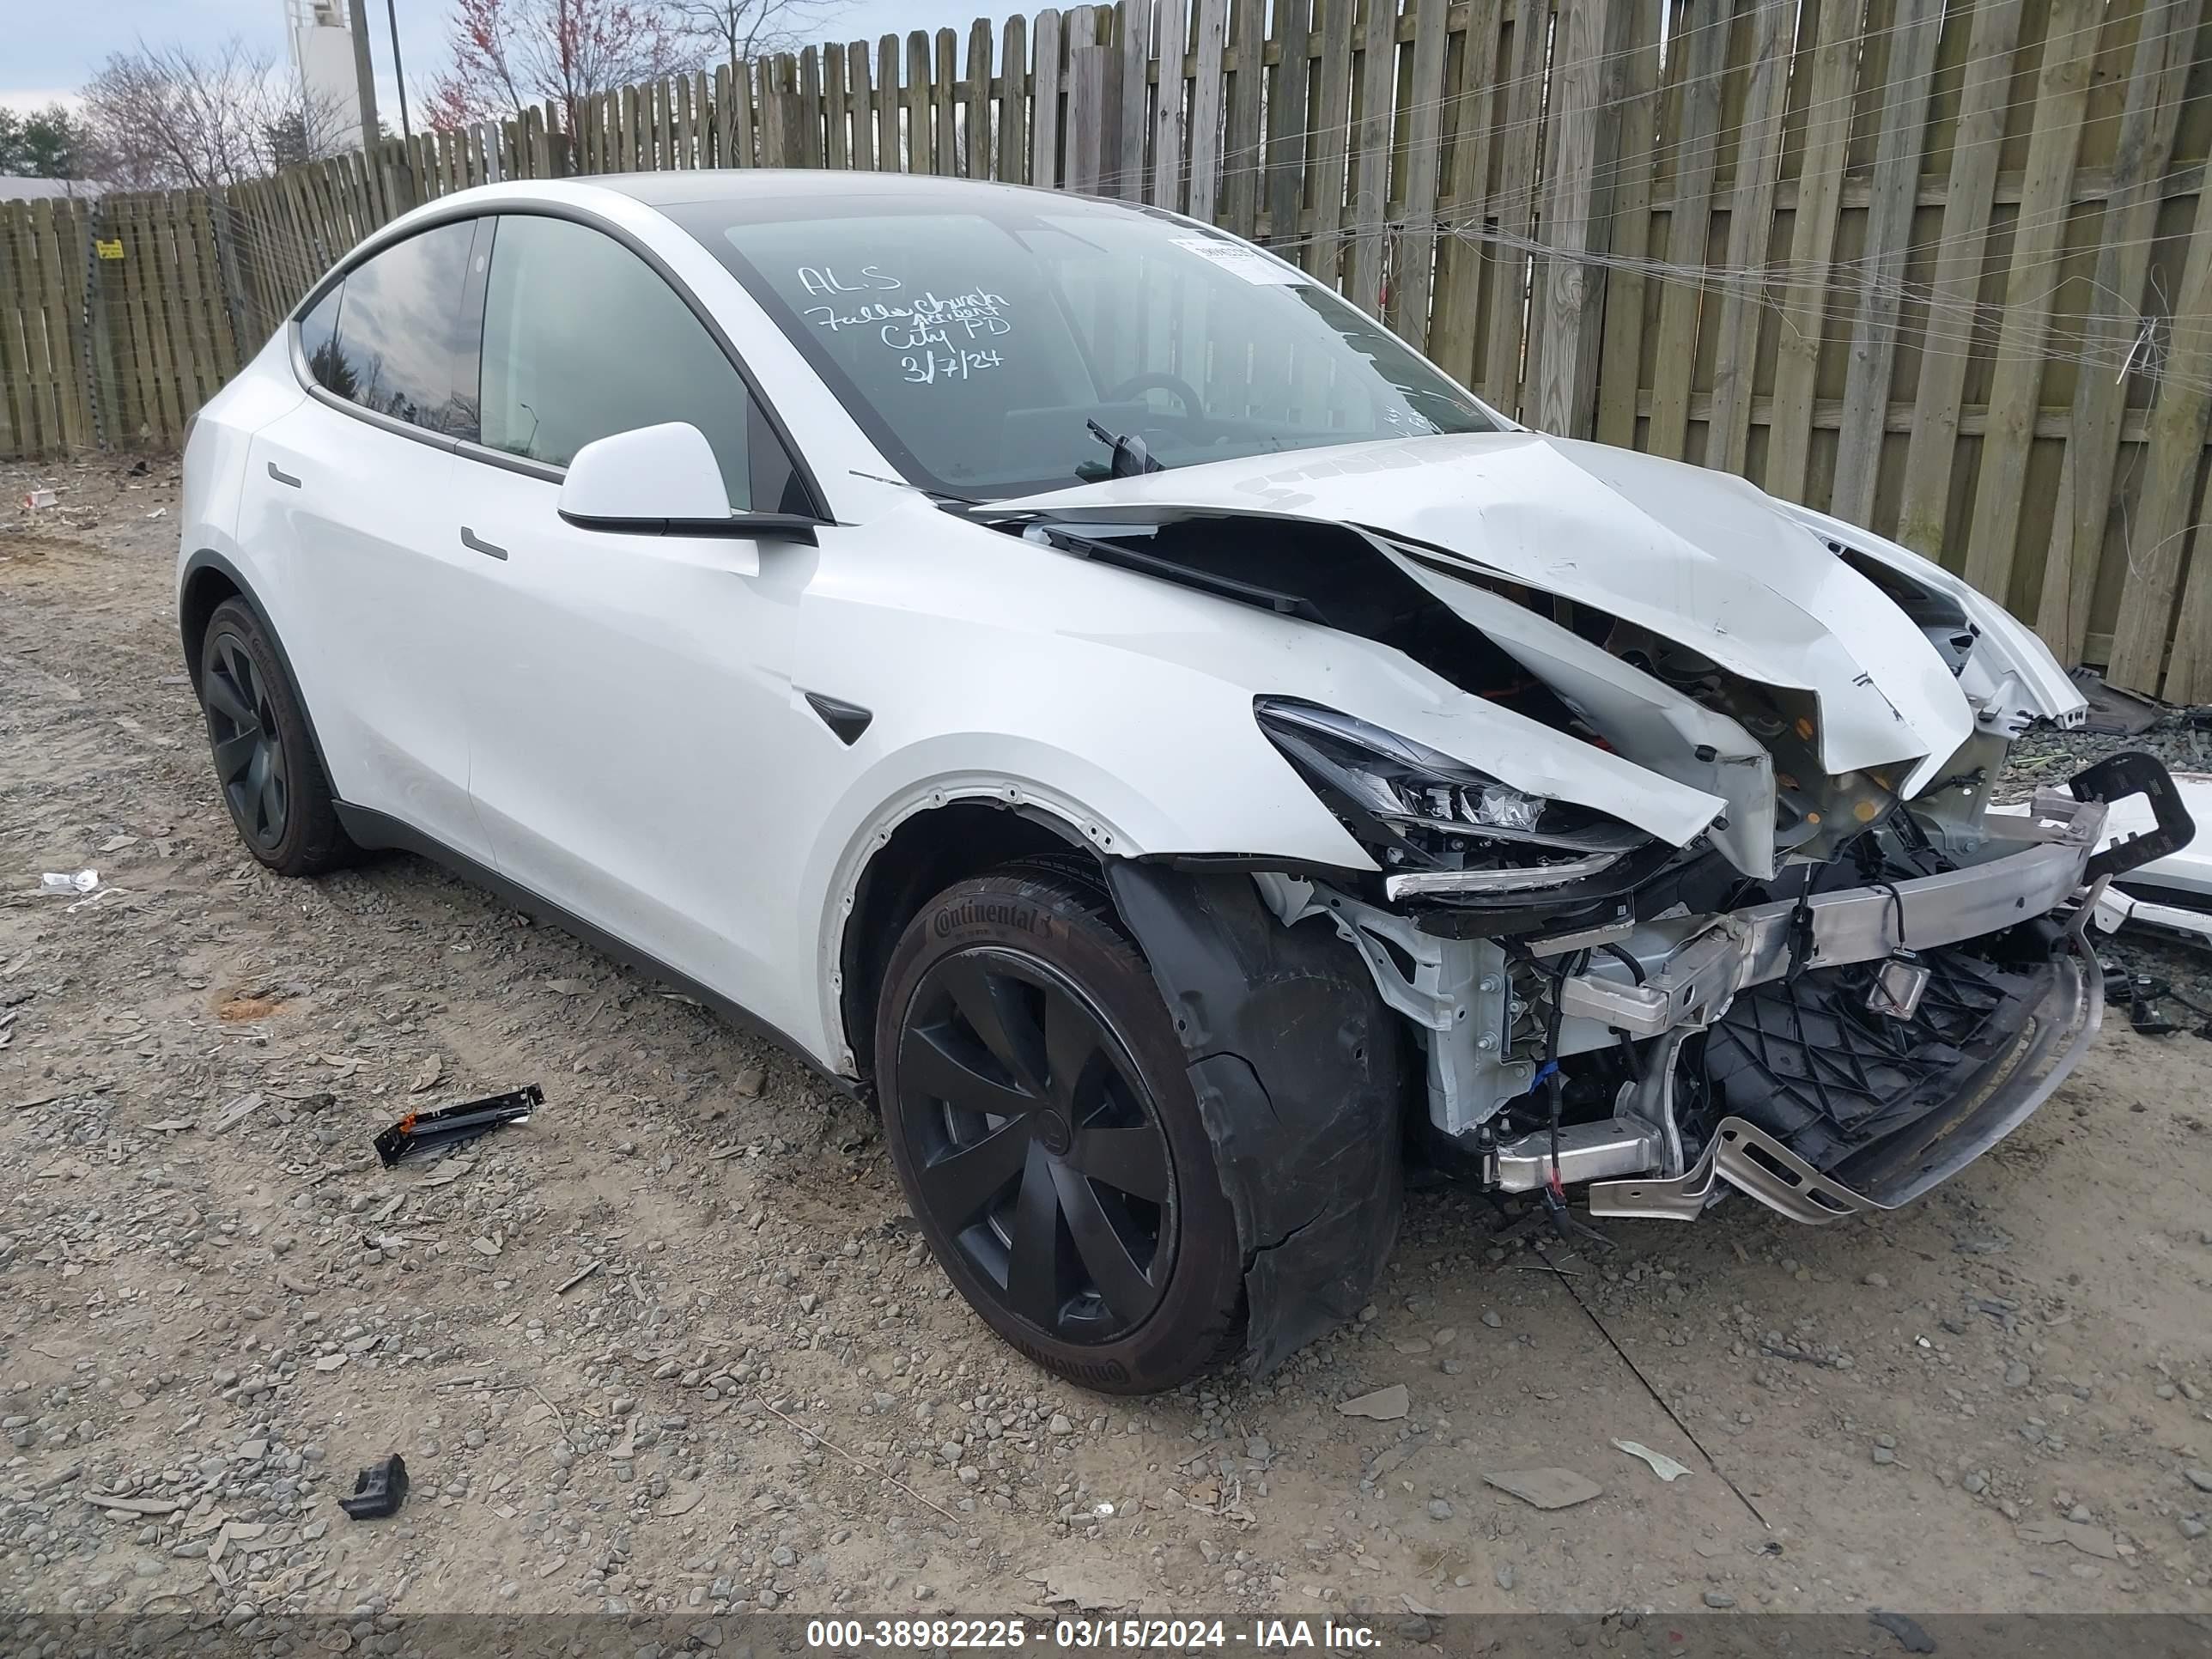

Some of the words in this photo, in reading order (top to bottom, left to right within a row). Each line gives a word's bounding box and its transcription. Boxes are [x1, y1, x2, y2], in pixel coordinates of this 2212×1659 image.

[803, 303, 914, 331] Falls
[913, 286, 1012, 315] Church
[880, 321, 957, 353] City
[955, 316, 1012, 339] PD
[902, 349, 1006, 385] 3/7/24
[933, 899, 1040, 939] Continental
